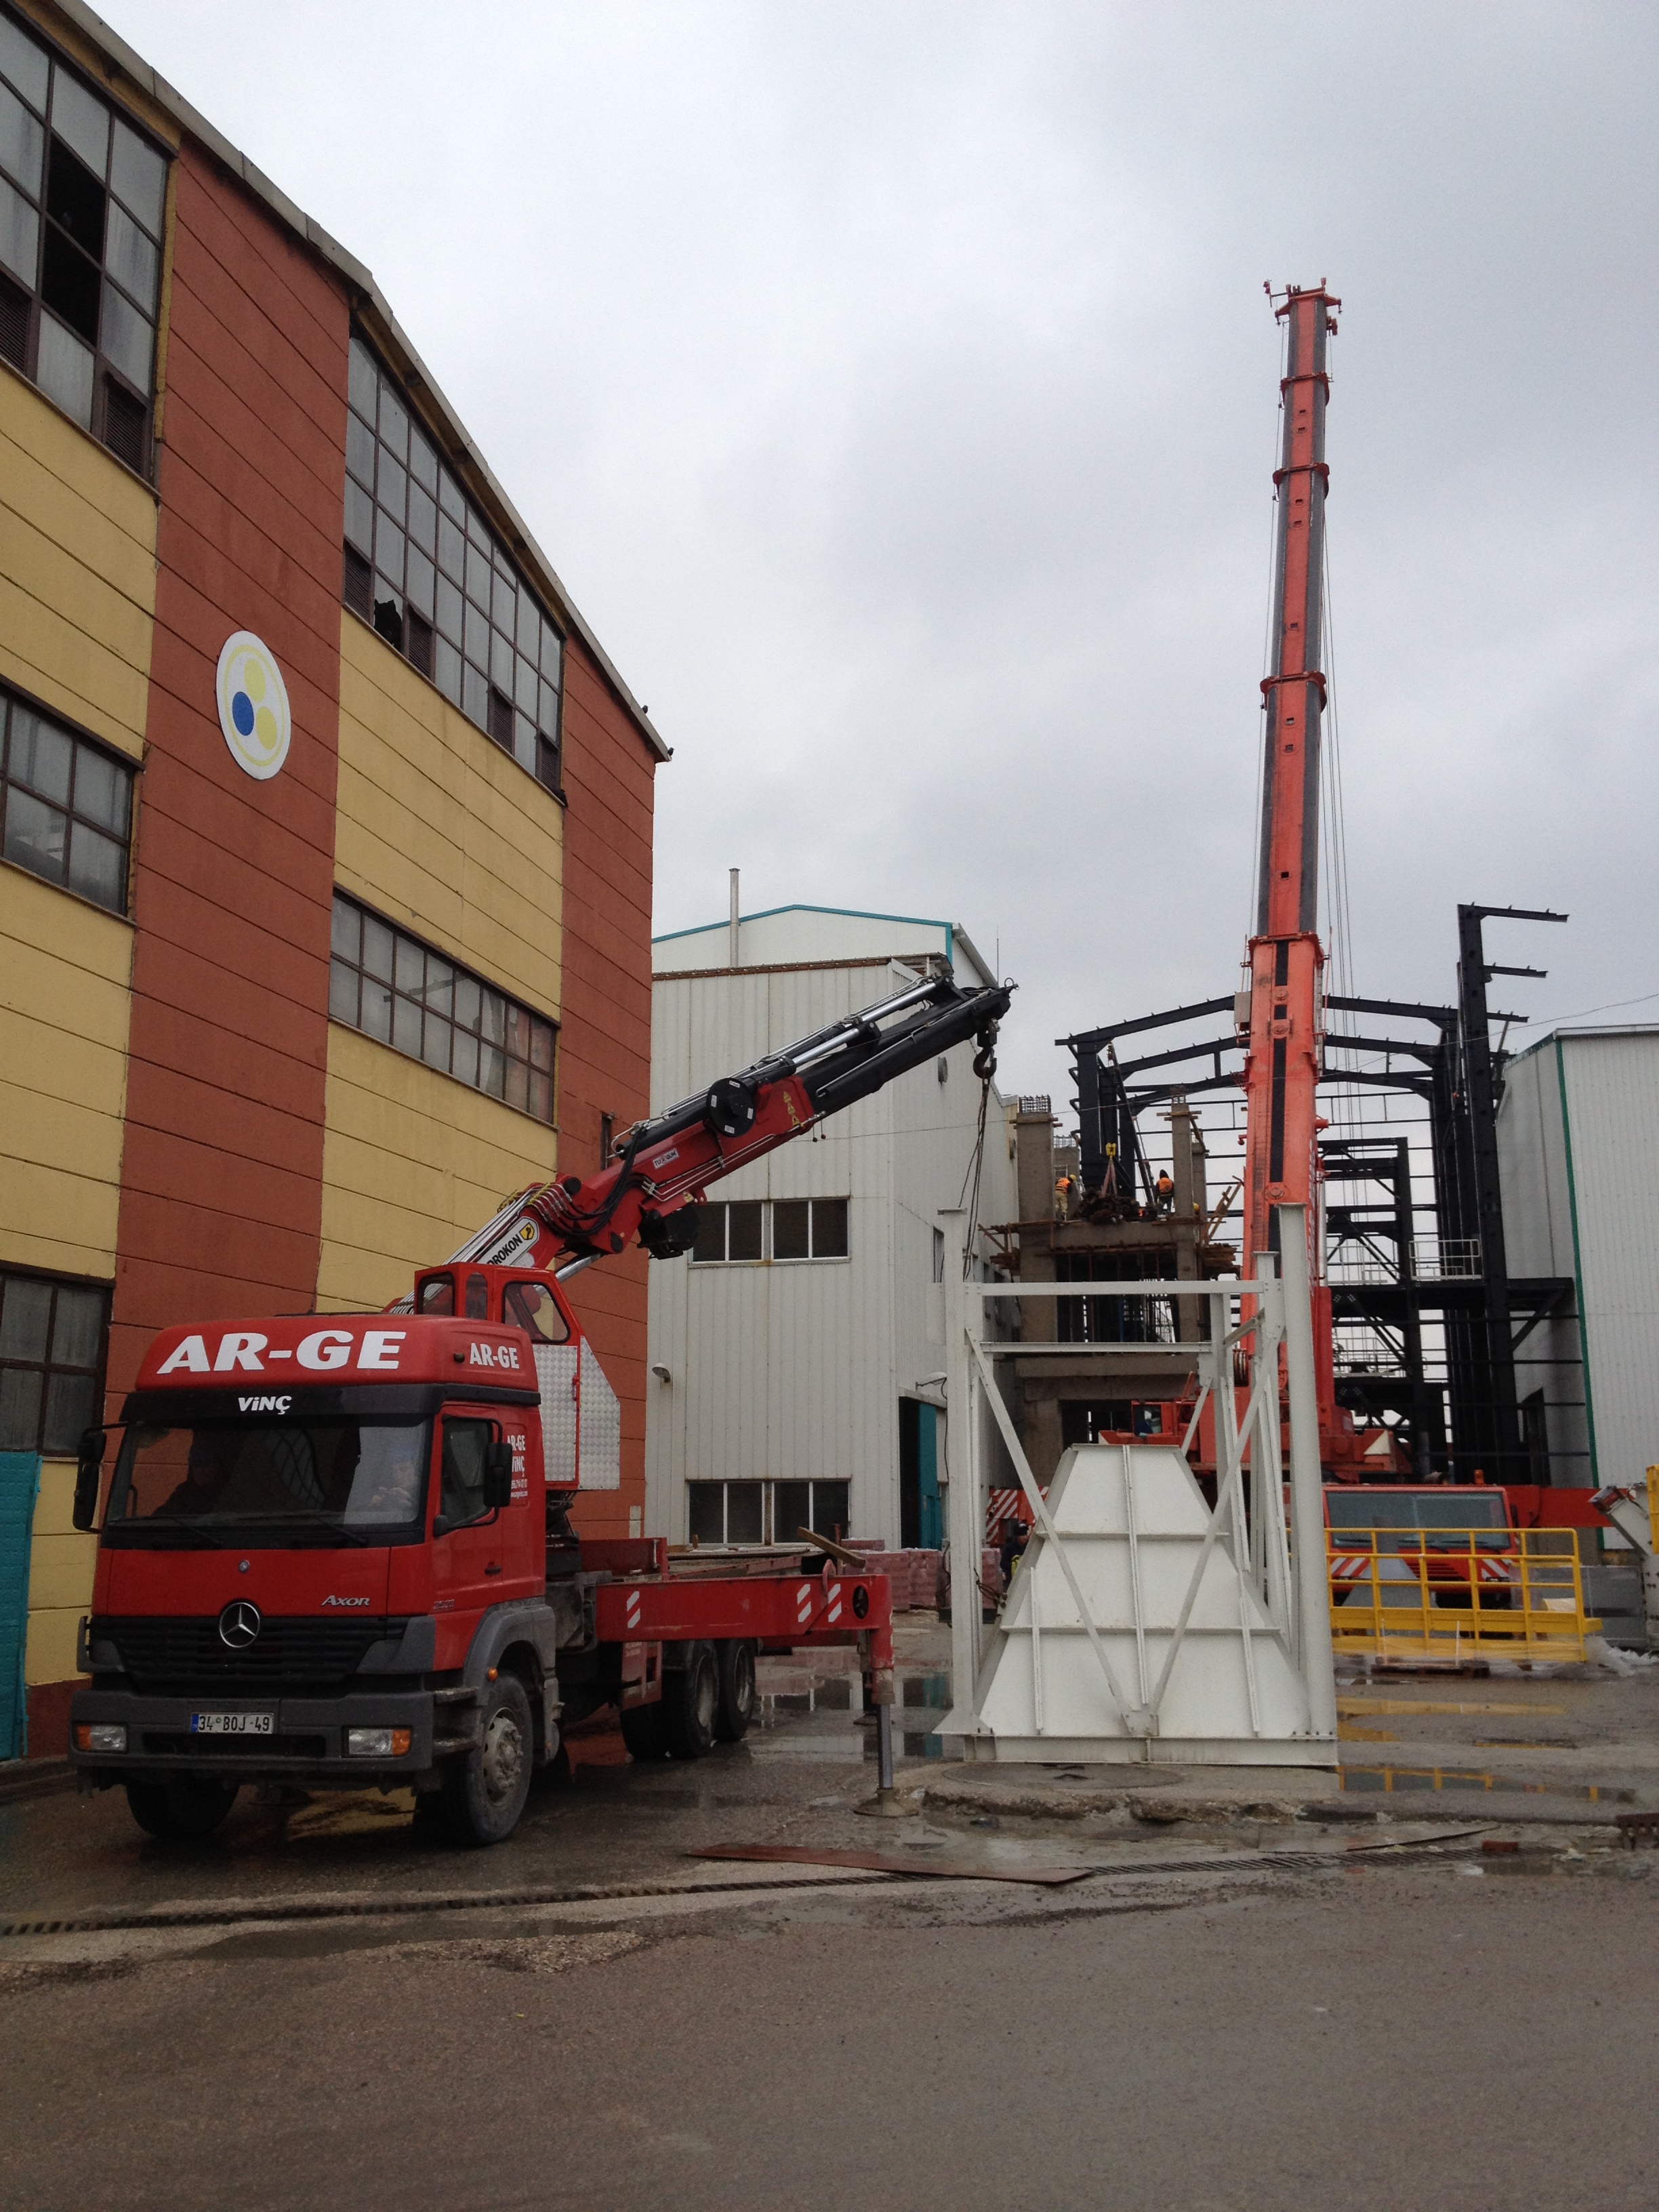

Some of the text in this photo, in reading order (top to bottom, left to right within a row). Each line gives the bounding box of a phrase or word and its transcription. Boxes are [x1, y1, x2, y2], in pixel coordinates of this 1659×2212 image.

[157, 1330, 407, 1374] AR-GE
[470, 1343, 520, 1369] AR-GE
[199, 1715, 270, 1732] 34 BOJ 49
